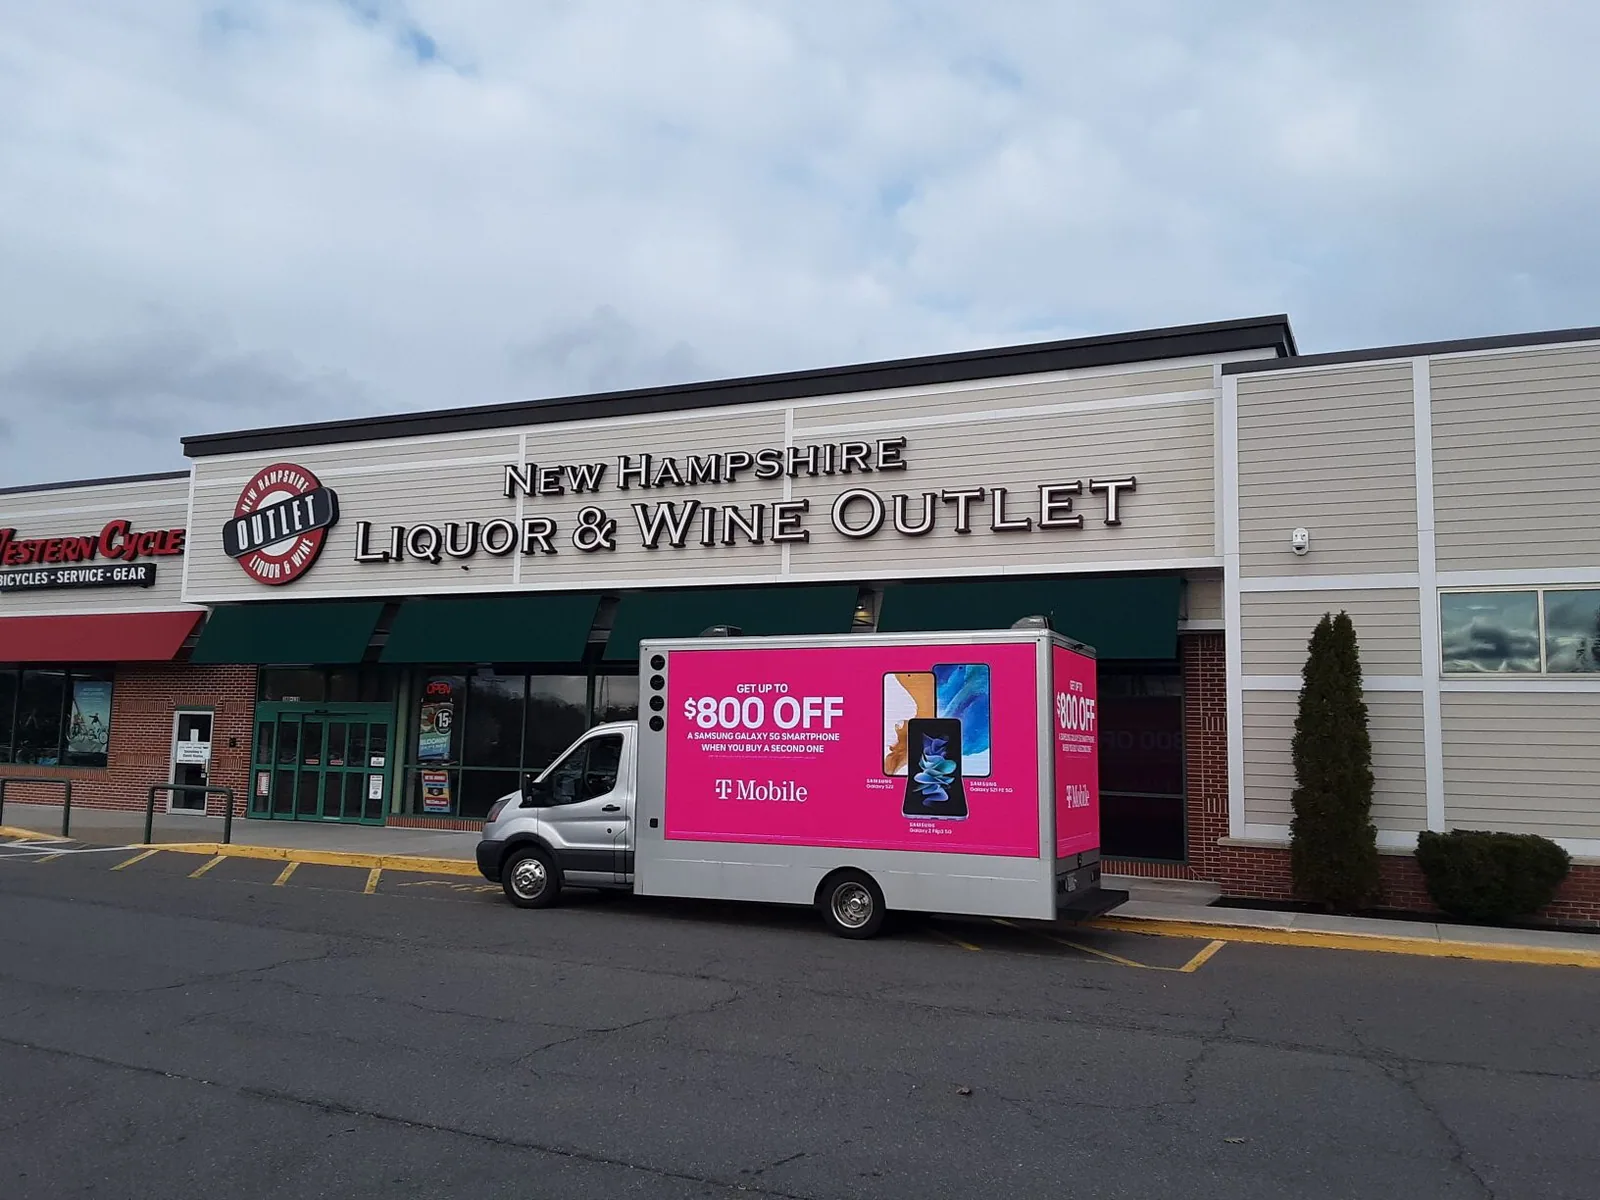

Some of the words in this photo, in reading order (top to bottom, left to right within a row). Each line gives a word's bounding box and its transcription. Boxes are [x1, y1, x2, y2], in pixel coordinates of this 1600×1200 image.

[504, 462, 608, 498] NEW
[616, 436, 908, 489] HAMPSHIRE
[241, 488, 258, 513] NEW
[257, 470, 310, 493] HAMPSHIRE
[236, 495, 315, 550] OUTLET
[354, 517, 558, 565] LIQUOR
[571, 505, 617, 552] &
[631, 499, 810, 549] WINE
[830, 475, 1137, 539] OUTLET
[99, 519, 186, 561] CYCLE
[56, 568, 104, 583] SERVICE
[113, 567, 146, 581] GEAR
[249, 554, 280, 579] LIQUOR
[283, 560, 291, 575] &
[291, 538, 314, 568] WINE
[427, 683, 452, 694] OPEN
[736, 683, 756, 693] GET
[758, 683, 772, 693] UP
[774, 683, 788, 693] TO
[684, 696, 765, 729] $800
[773, 696, 844, 729] OFF
[1057, 691, 1078, 730] $800
[1079, 697, 1095, 731] OFF
[694, 732, 733, 740] SAMSUNG
[735, 732, 767, 740] GALAXY
[769, 732, 780, 740] 5G
[781, 732, 839, 741] SMARTPHONE
[701, 743, 726, 751] WHEN
[727, 743, 744, 751] YOU
[746, 743, 762, 751] BUY
[771, 744, 805, 752] SECOND
[806, 744, 824, 752] ONE
[736, 779, 808, 802] Mobile
